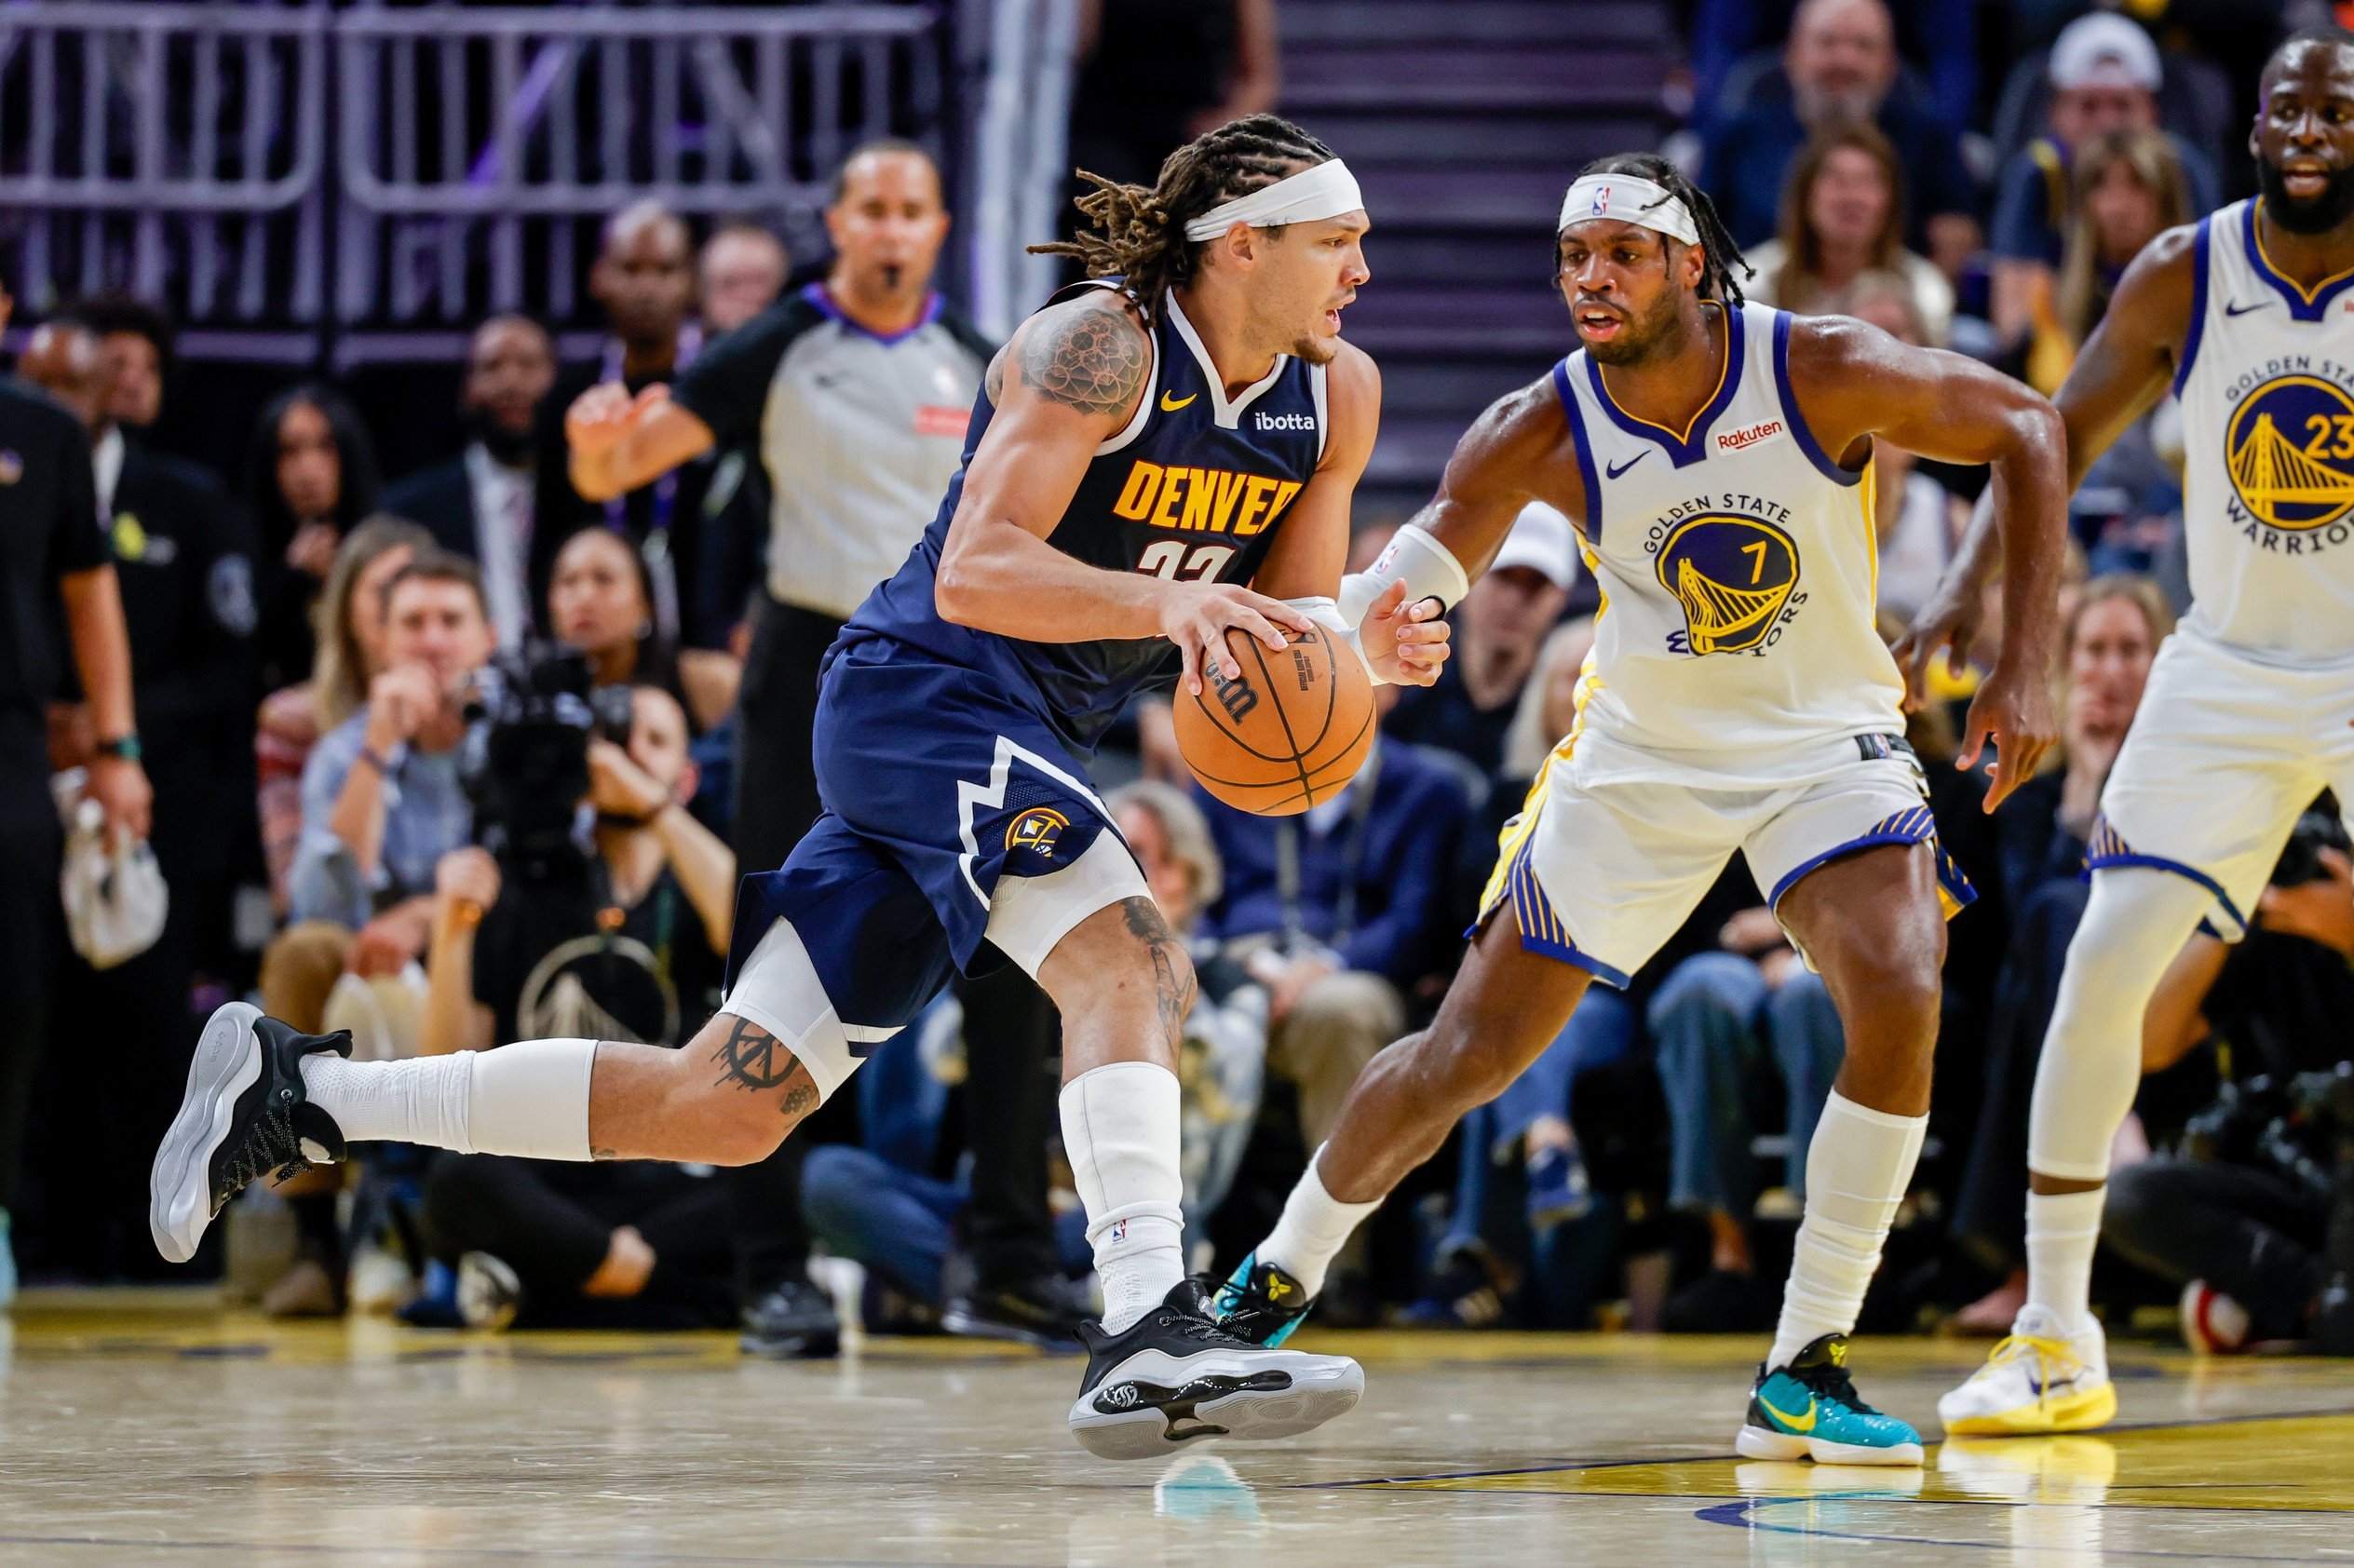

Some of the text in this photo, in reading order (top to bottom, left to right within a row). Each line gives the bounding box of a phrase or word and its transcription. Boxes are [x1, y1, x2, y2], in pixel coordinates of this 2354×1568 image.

[2225, 356, 2310, 403] GOLDEN
[1254, 412, 1315, 431] ibotta
[1717, 420, 1782, 450] Rakuten
[2304, 413, 2354, 460] 23
[1644, 493, 1792, 555] GOLDEN STATE
[2225, 494, 2354, 556] WARRIO
[1740, 539, 1767, 585] 7
